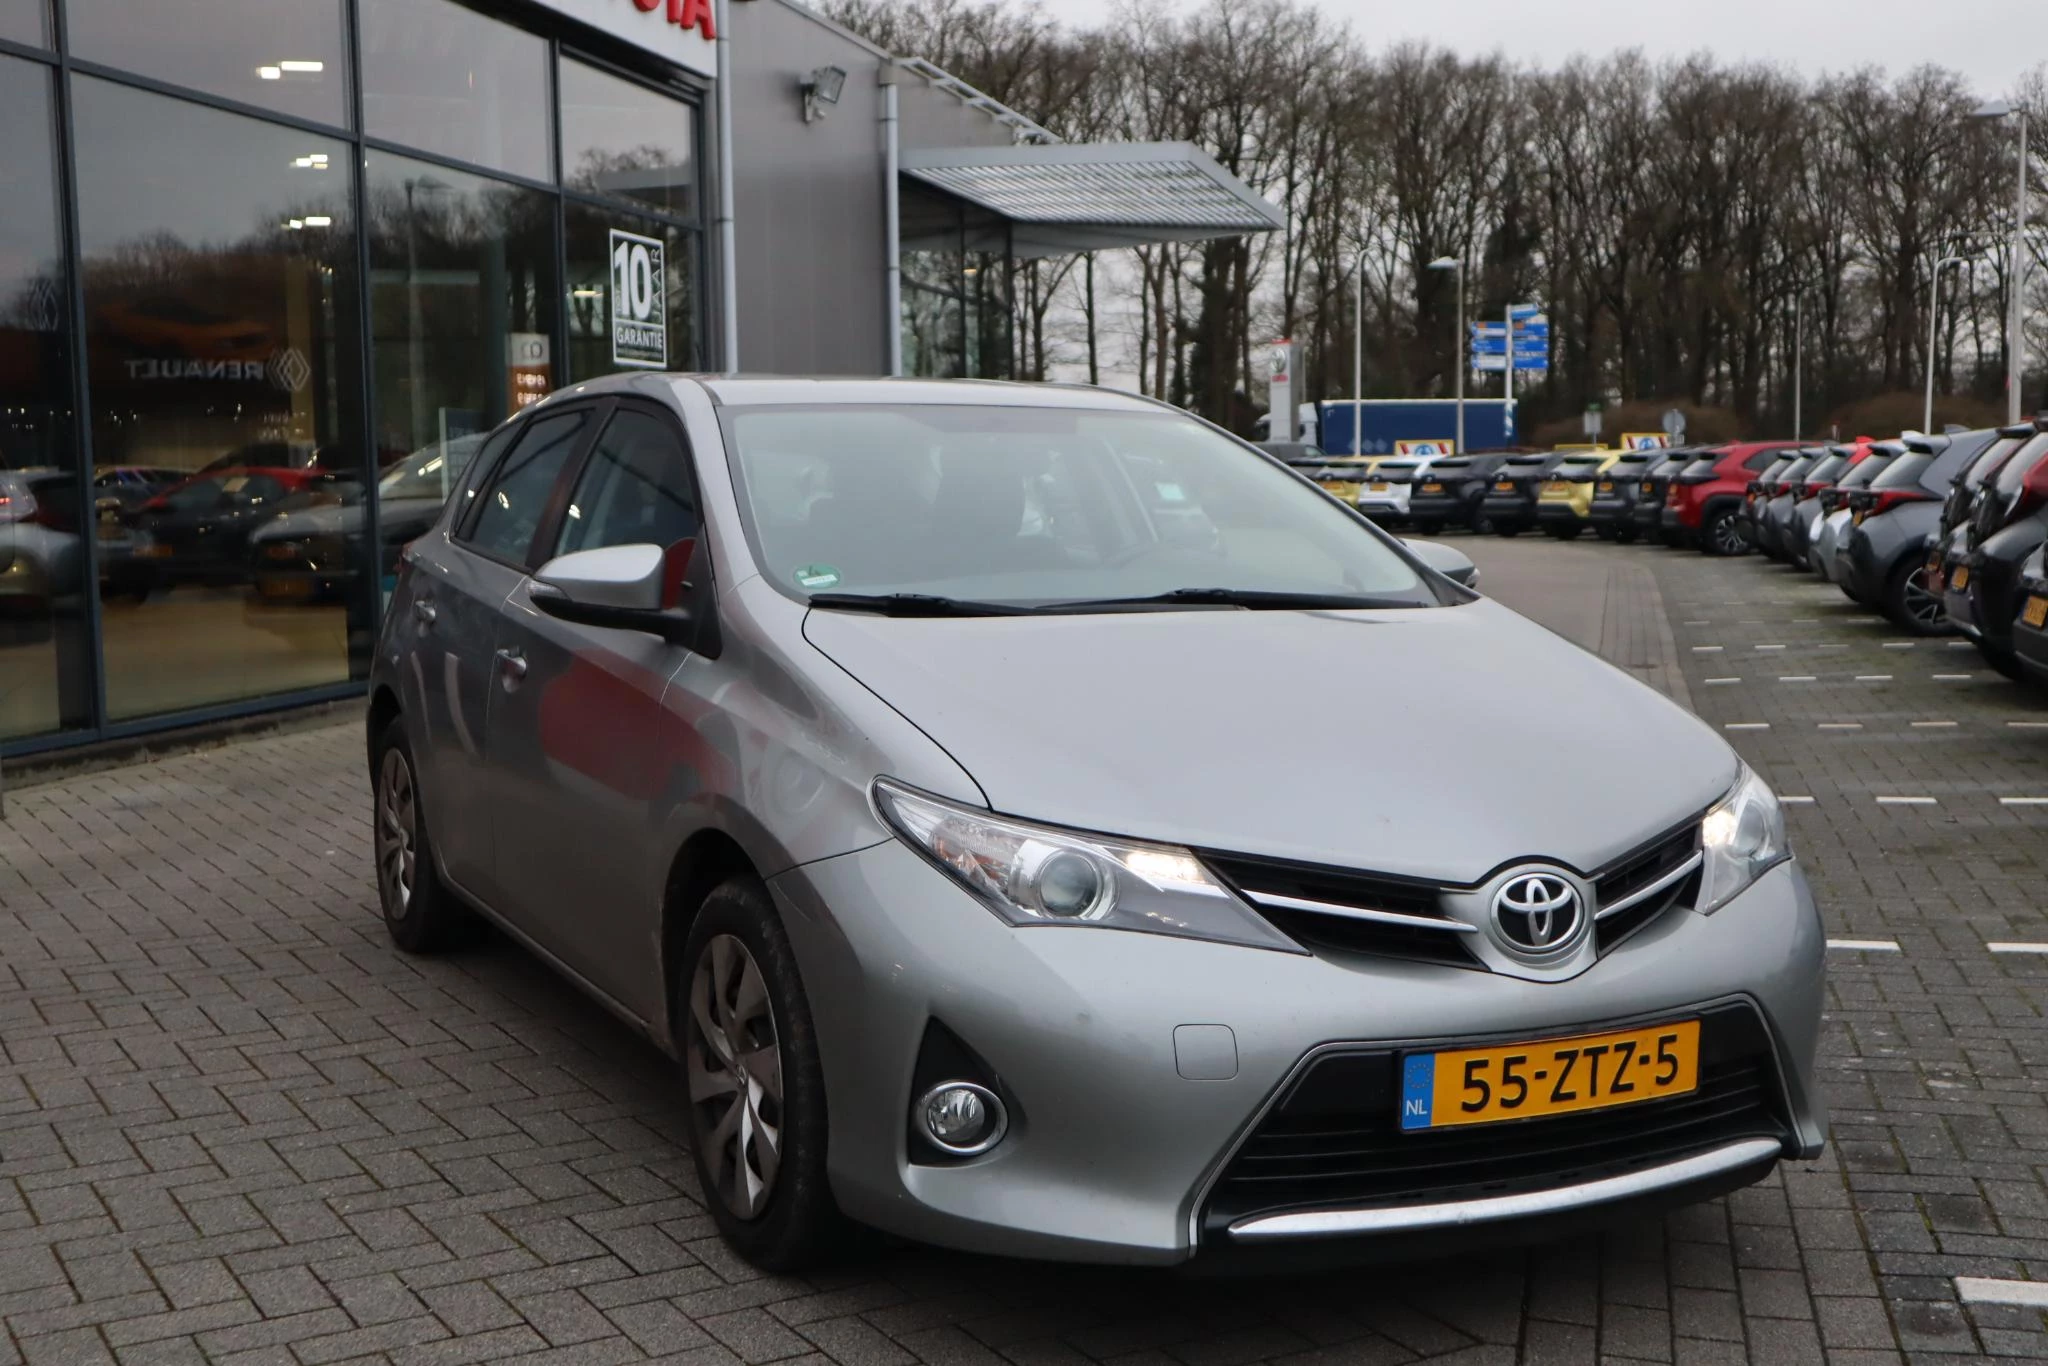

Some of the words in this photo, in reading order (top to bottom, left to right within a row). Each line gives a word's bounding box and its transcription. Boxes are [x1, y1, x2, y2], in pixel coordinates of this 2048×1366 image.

[614, 241, 652, 319] 10
[651, 248, 662, 323] JAAR
[616, 327, 663, 347] GARANTIE
[1406, 1098, 1428, 1116] NL
[1461, 1034, 1679, 1113] 55-ZTZ-5
